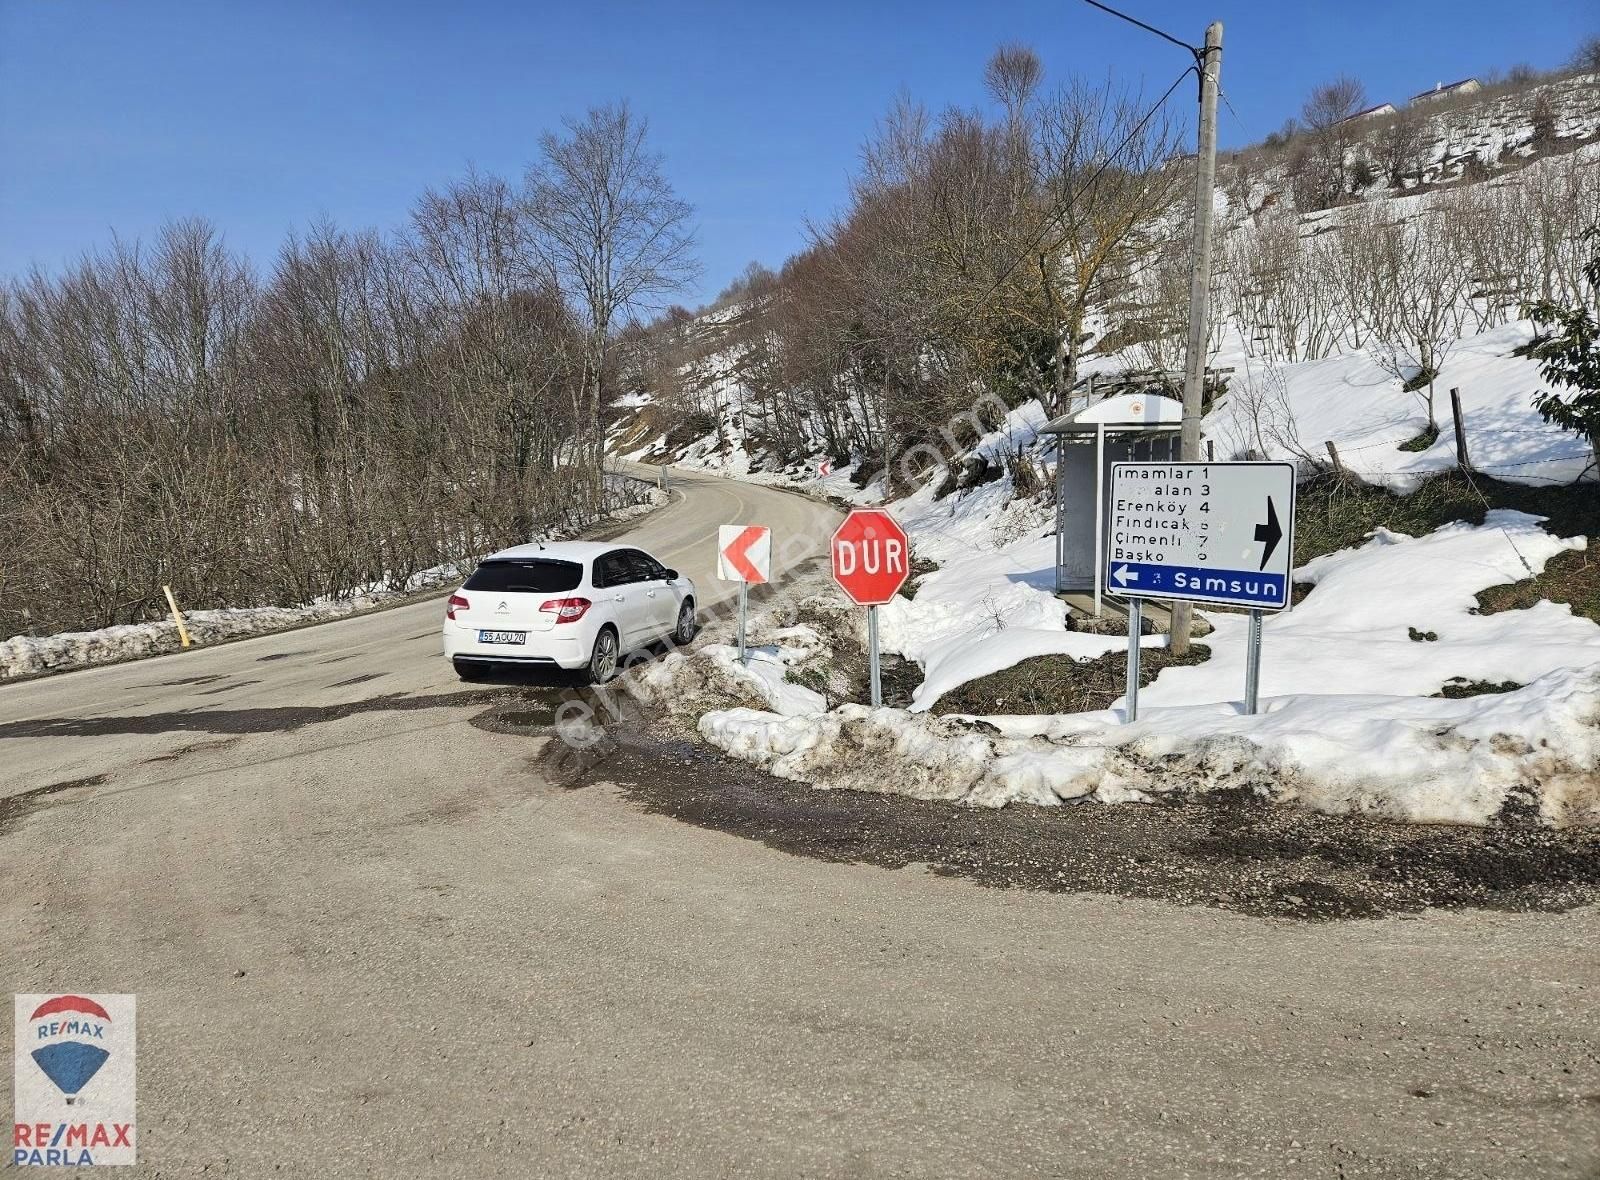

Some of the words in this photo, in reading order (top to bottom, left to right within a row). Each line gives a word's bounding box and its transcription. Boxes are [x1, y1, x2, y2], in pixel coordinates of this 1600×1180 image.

[1202, 467, 1208, 479] 1
[1201, 484, 1210, 496] 3
[1117, 500, 1187, 516] Erenköy
[1199, 501, 1210, 513] 4
[838, 538, 903, 576] DUR
[1174, 572, 1278, 597] Samsun
[484, 632, 494, 641] 55
[514, 633, 524, 642] 70
